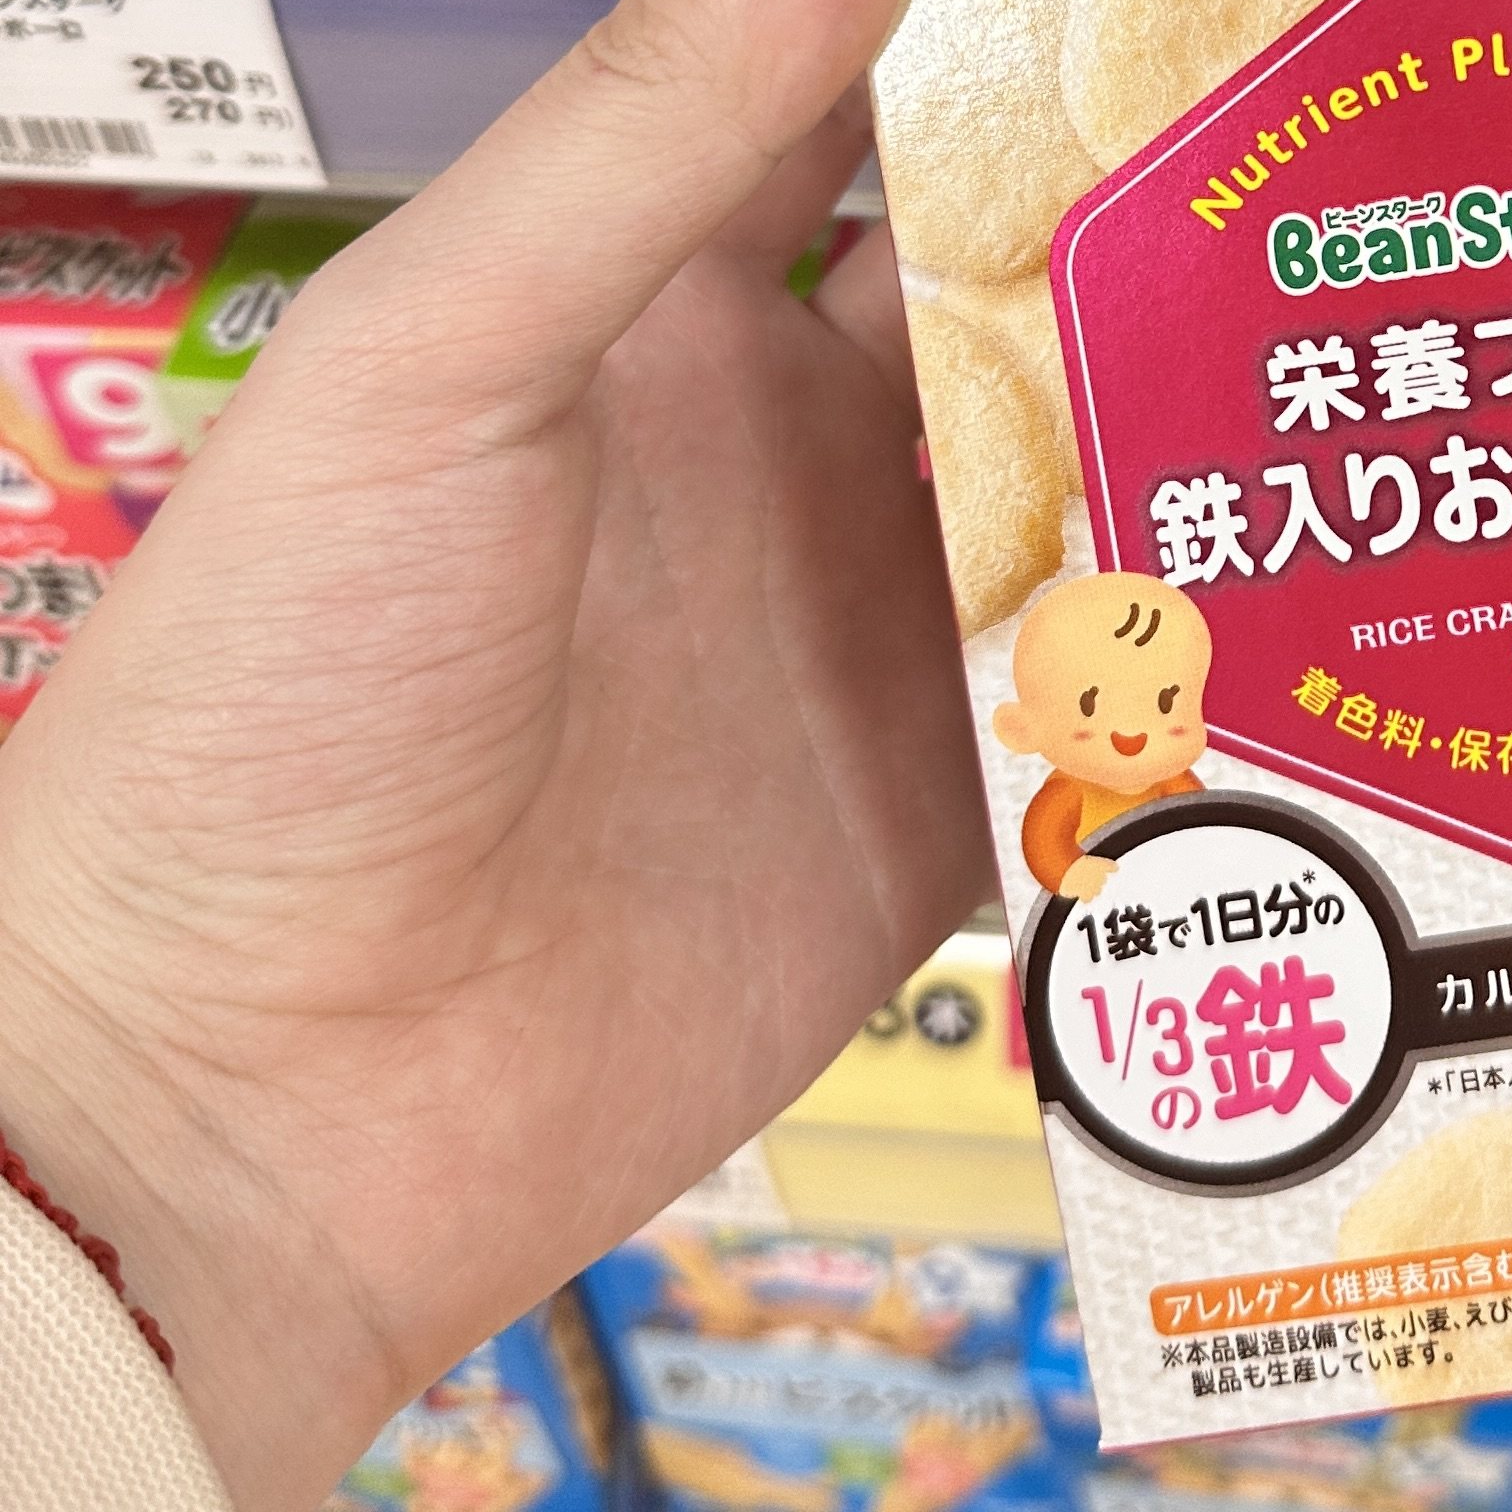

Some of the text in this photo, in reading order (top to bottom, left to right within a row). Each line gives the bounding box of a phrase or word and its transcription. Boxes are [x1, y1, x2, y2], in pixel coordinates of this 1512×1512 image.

[1188, 50, 1430, 232] Nutrient
[1324, 195, 1443, 230] ビーンスターク
[1348, 614, 1436, 654] RICE
[1081, 978, 1194, 1082] 1/3
[1195, 954, 1353, 1121] 鉄
[1150, 1085, 1203, 1130] の
[1190, 1338, 1456, 1399] 製品も生産しています。
